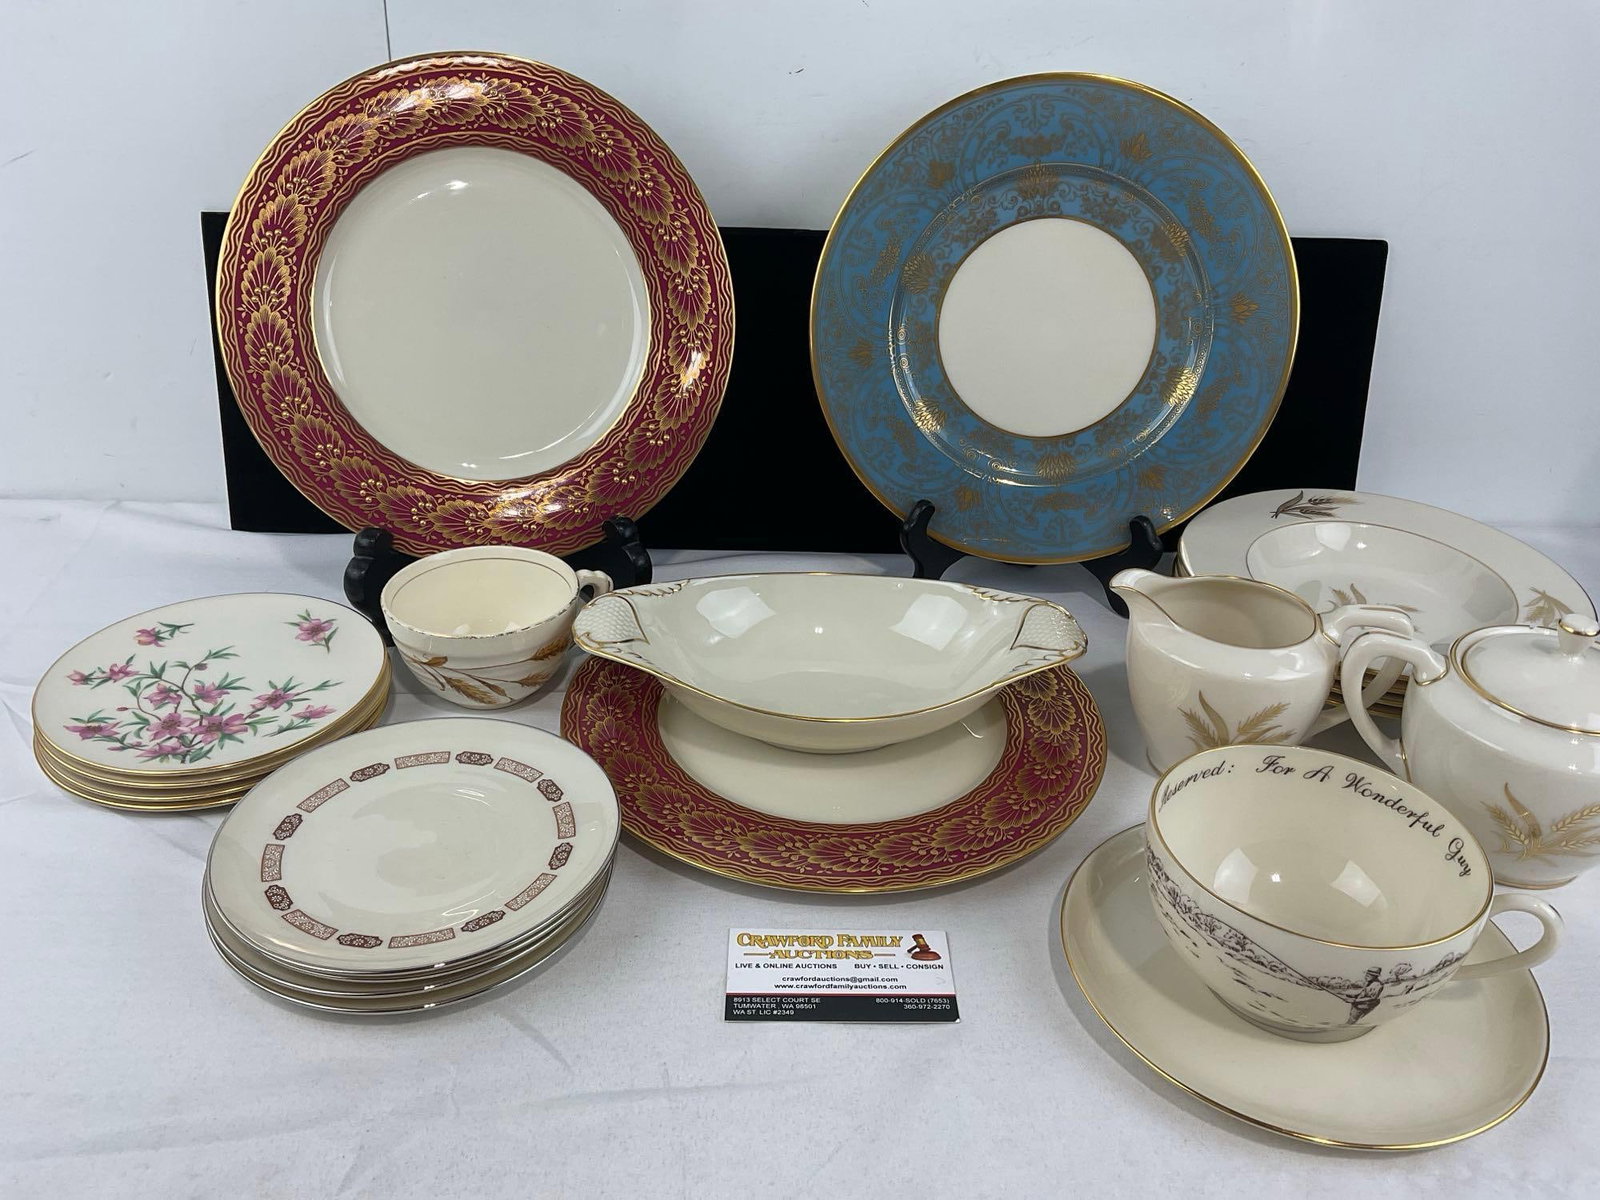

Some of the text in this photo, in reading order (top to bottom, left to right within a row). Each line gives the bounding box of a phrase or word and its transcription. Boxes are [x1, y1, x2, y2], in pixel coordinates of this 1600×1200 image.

[1255, 755, 1297, 773] For
[1303, 765, 1335, 783] A
[1341, 772, 1445, 838] Wonderful
[1444, 837, 1472, 877] Guy
[736, 932, 904, 949] CRAWFORD FAMILY
[769, 949, 874, 960] AUCTIONS
[781, 975, 899, 984] crawfordauctions@gmail.com
[774, 983, 907, 991] www.crawfordfamilyauctions.com
